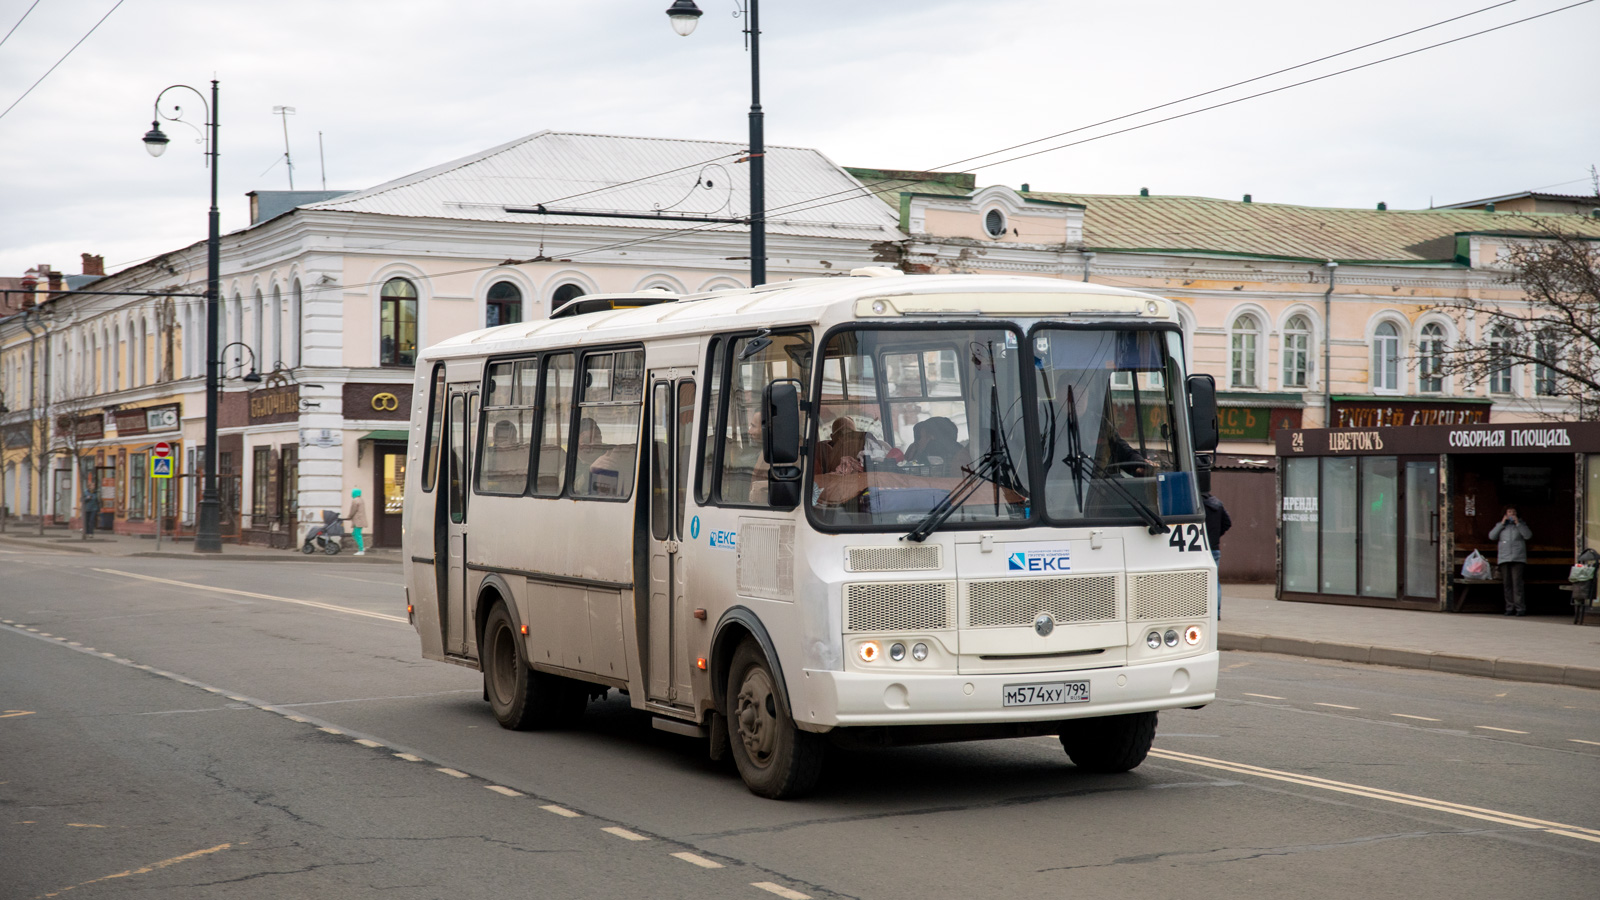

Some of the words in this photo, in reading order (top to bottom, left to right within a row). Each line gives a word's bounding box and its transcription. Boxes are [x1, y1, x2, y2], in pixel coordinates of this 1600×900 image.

[251, 391, 298, 418] БУЛОЧНАЯ
[1292, 433, 1304, 447] 24
[1329, 431, 1384, 453] ЦВЕТОКЪ
[1449, 430, 1505, 447] СОБОРНАЯ
[1511, 429, 1571, 448] ПЛОЩАДЬ
[1283, 496, 1318, 512] АРЕНДА
[718, 530, 736, 544] ЕКС
[1169, 524, 1209, 552] 421
[1028, 557, 1070, 571] ЕКС
[1007, 686, 1062, 703] М574ХУ
[1066, 684, 1086, 696] 799
